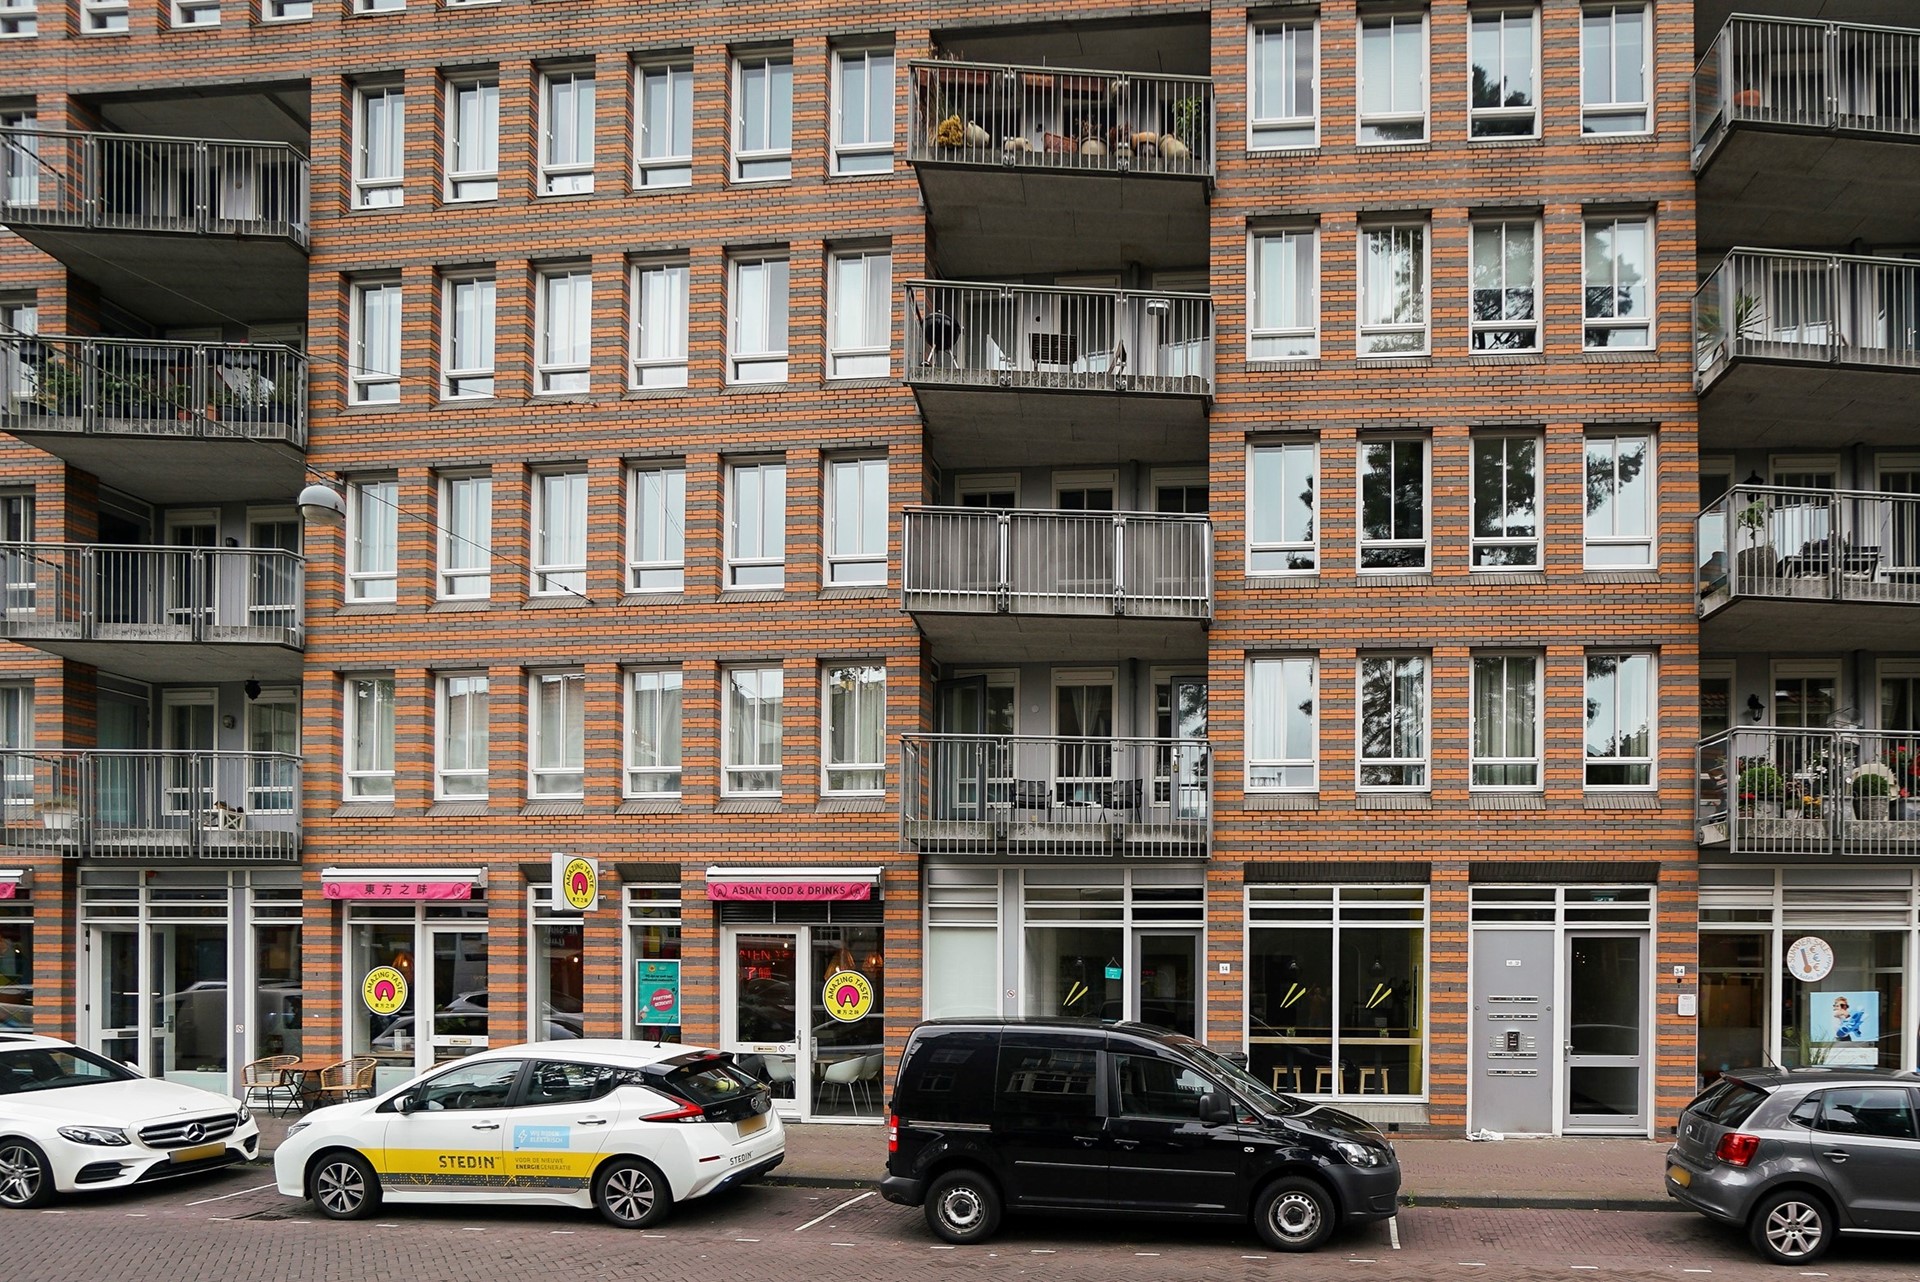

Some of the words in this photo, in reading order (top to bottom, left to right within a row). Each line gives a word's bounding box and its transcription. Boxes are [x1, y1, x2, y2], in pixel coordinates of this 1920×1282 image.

[566, 863, 583, 887] AMAZING
[585, 866, 594, 887] TASTE
[364, 884, 428, 895] 東方之味
[732, 886, 762, 895] ASIAN
[766, 886, 794, 895] FOOD
[797, 886, 804, 895] &
[808, 886, 846, 895] DRINKS
[1788, 938, 1811, 963] SUMMER
[1814, 939, 1831, 953] SALE
[367, 971, 390, 994] AMAZING
[391, 974, 404, 994] TASTE
[828, 976, 854, 1000] AMAZING
[855, 978, 869, 1001] TASTE
[439, 1155, 495, 1168] STEDIN
[730, 1152, 752, 1165] STEDIN
